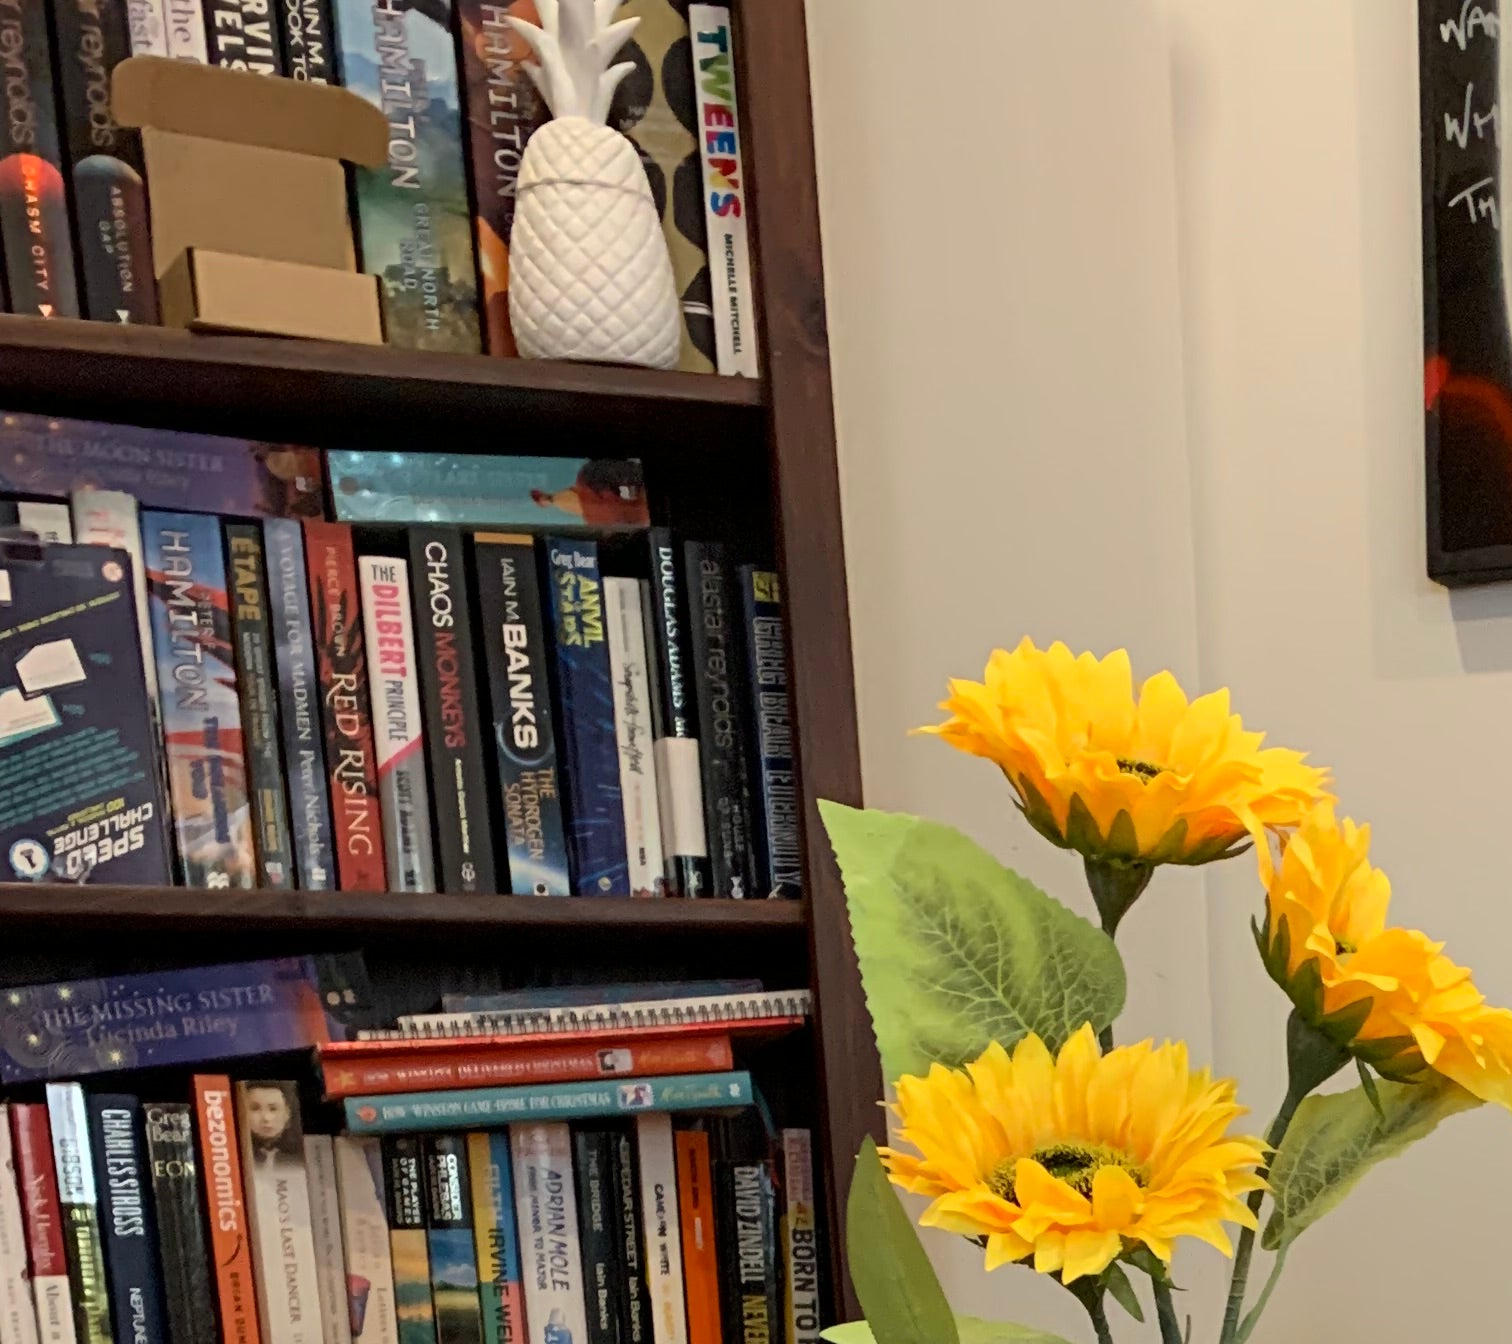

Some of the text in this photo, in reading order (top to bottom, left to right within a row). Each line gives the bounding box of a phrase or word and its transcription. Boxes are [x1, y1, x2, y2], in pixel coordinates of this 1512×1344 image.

[0, 18, 34, 147] reynolds
[78, 25, 115, 148] reynolds
[371, 0, 421, 190] HAMILTON
[480, 3, 522, 198] HAMILTON
[697, 25, 742, 218] TWEENS
[20, 165, 49, 291] CHASM CITY
[111, 185, 134, 293] ABSOLUTION
[420, 267, 441, 333] NORTH
[724, 233, 743, 355] MICHELLE MITCHELL
[278, 547, 299, 616] VOYAGE
[371, 564, 397, 583] THE
[424, 541, 455, 629] CHAOS
[500, 557, 517, 598] IAIN
[558, 570, 583, 647] STARS
[658, 545, 680, 638] DOUGLAS
[159, 528, 208, 712] HAMILTON
[287, 620, 304, 656] FOR
[330, 602, 347, 658] BROWN
[371, 583, 407, 679] DILBERT
[576, 574, 605, 649] ANVIL
[668, 639, 684, 708] ADAMS
[752, 615, 784, 684] GREG
[290, 662, 312, 741] MADMEN
[384, 678, 409, 743] PRINCIPLE
[432, 630, 466, 750] MONKEYS
[502, 622, 538, 750] BANKS
[706, 645, 735, 749] reynolds
[759, 689, 793, 759] BEAR
[327, 671, 373, 857] RED RISING
[538, 766, 557, 799] THE
[53, 802, 154, 856] CHALLENGE
[66, 823, 145, 876] SPEED
[505, 782, 525, 847] SONATA
[520, 770, 545, 861] HYDROGEN
[764, 768, 802, 888] ETERNITY
[41, 983, 273, 1030] THE MISSING SISTER
[86, 1015, 240, 1049] Lucinda Riley
[147, 1108, 192, 1129] Greg
[151, 1122, 193, 1143] Bear
[412, 1100, 463, 1118] WINSTON
[528, 1094, 551, 1111] FOR
[551, 1090, 613, 1109] CHRISTMAS
[101, 1108, 145, 1238] CHARLES STROSS
[154, 1159, 196, 1178] EON
[203, 1089, 238, 1233] bezonomics
[407, 1156, 421, 1223] THE PLAYER
[437, 1153, 455, 1220] PHLEBAS
[446, 1153, 463, 1221] CONSIDER
[733, 1165, 764, 1218] DAVID
[402, 1177, 415, 1223] GAMES
[543, 1168, 570, 1292] ADRIAN MOLE
[280, 1226, 302, 1324] LAST DANCER
[488, 1227, 509, 1297] IRVINE
[531, 1193, 549, 1291] MINOR MAJOR
[588, 1149, 609, 1331] THE BRIDGE Iain Banks
[736, 1215, 767, 1285] ZINDELL
[791, 1227, 818, 1293] BORN
[230, 1271, 244, 1311] BRIAN
[624, 1211, 642, 1342] STREET Iain Banks
[794, 1297, 819, 1333] TO
